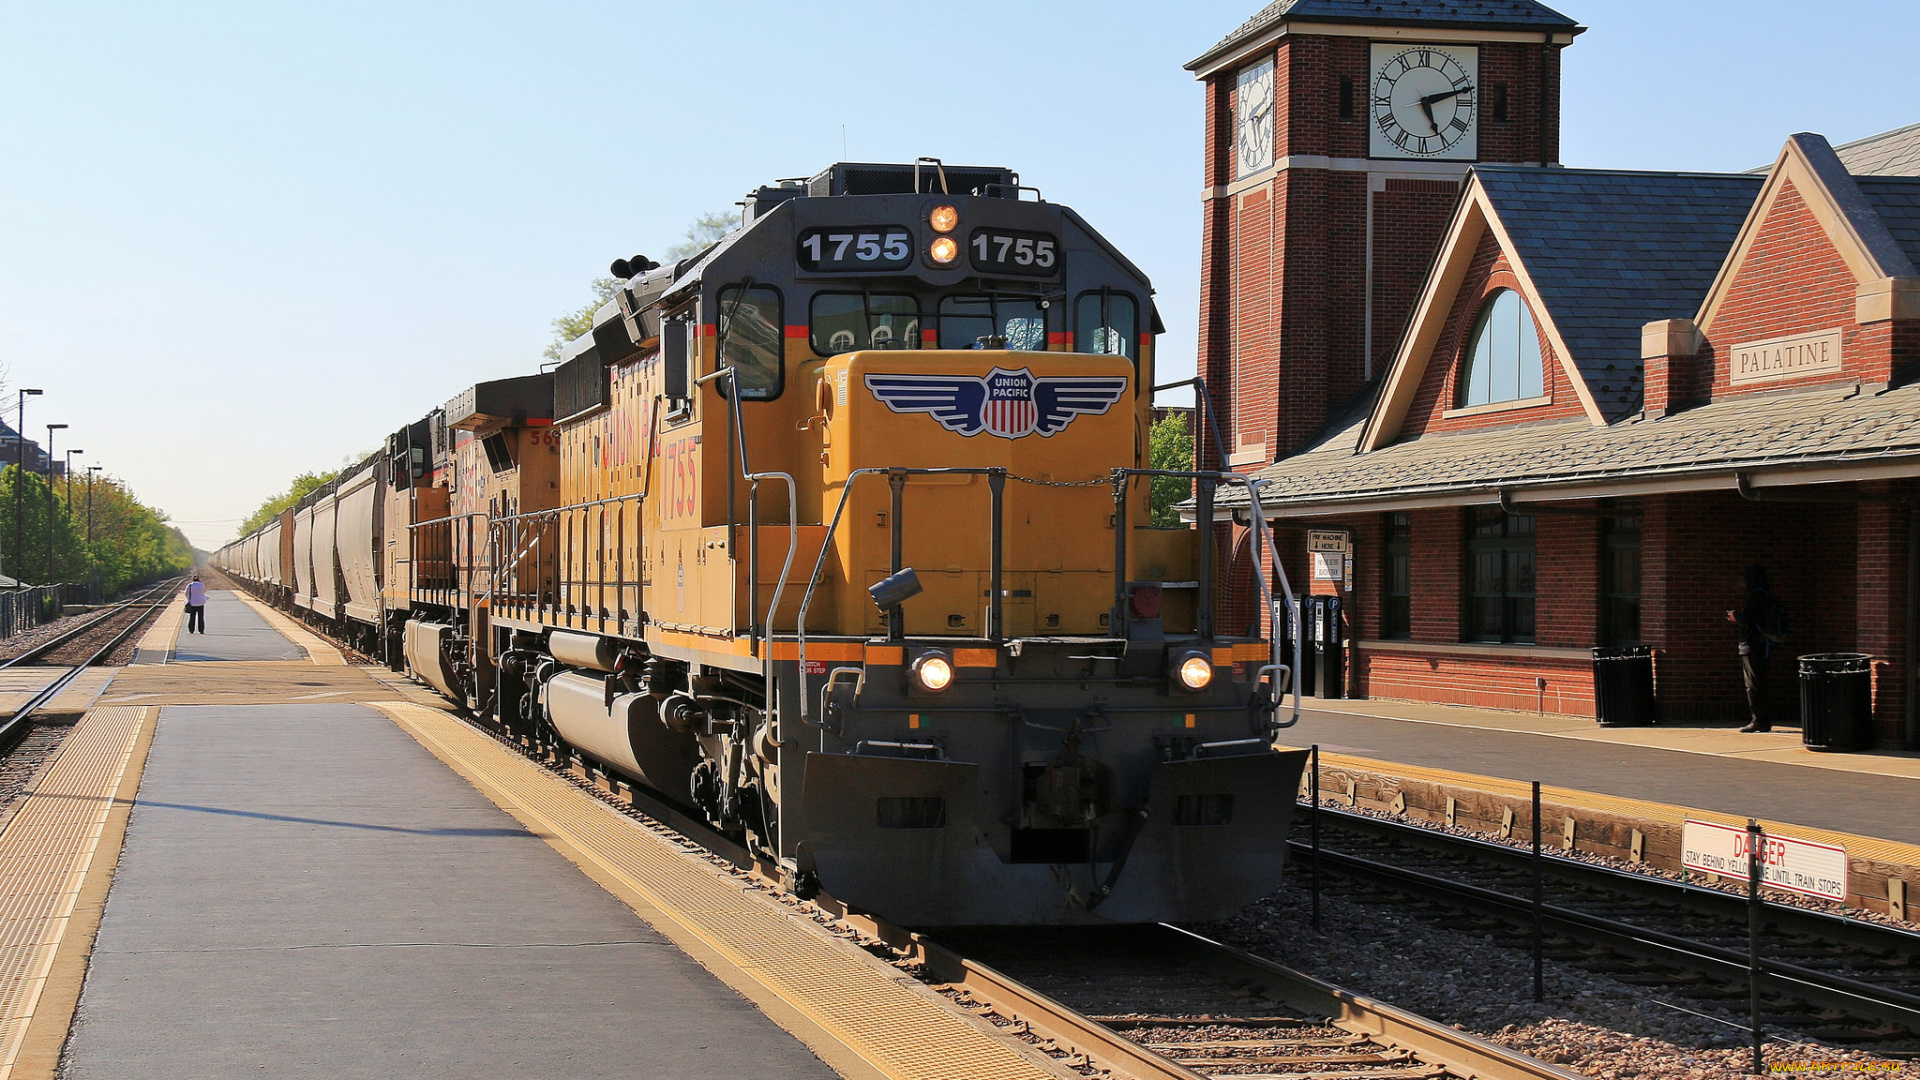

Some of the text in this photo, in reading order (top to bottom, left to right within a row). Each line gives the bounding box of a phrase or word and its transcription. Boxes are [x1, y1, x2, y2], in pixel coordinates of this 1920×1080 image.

[803, 233, 909, 261] 1755
[972, 234, 1055, 267] 1755
[1740, 341, 1829, 373] PALATINE
[993, 388, 1029, 397] PACIFIC
[995, 378, 1027, 387] UNION
[663, 435, 696, 520] 1755
[1686, 850, 1701, 864] STAY
[1703, 853, 1724, 869] BEHIND
[1727, 859, 1749, 874] YELLO
[1772, 868, 1792, 884] UNTIL
[1794, 873, 1815, 889] TRAIN
[1818, 878, 1841, 895] STOPS
